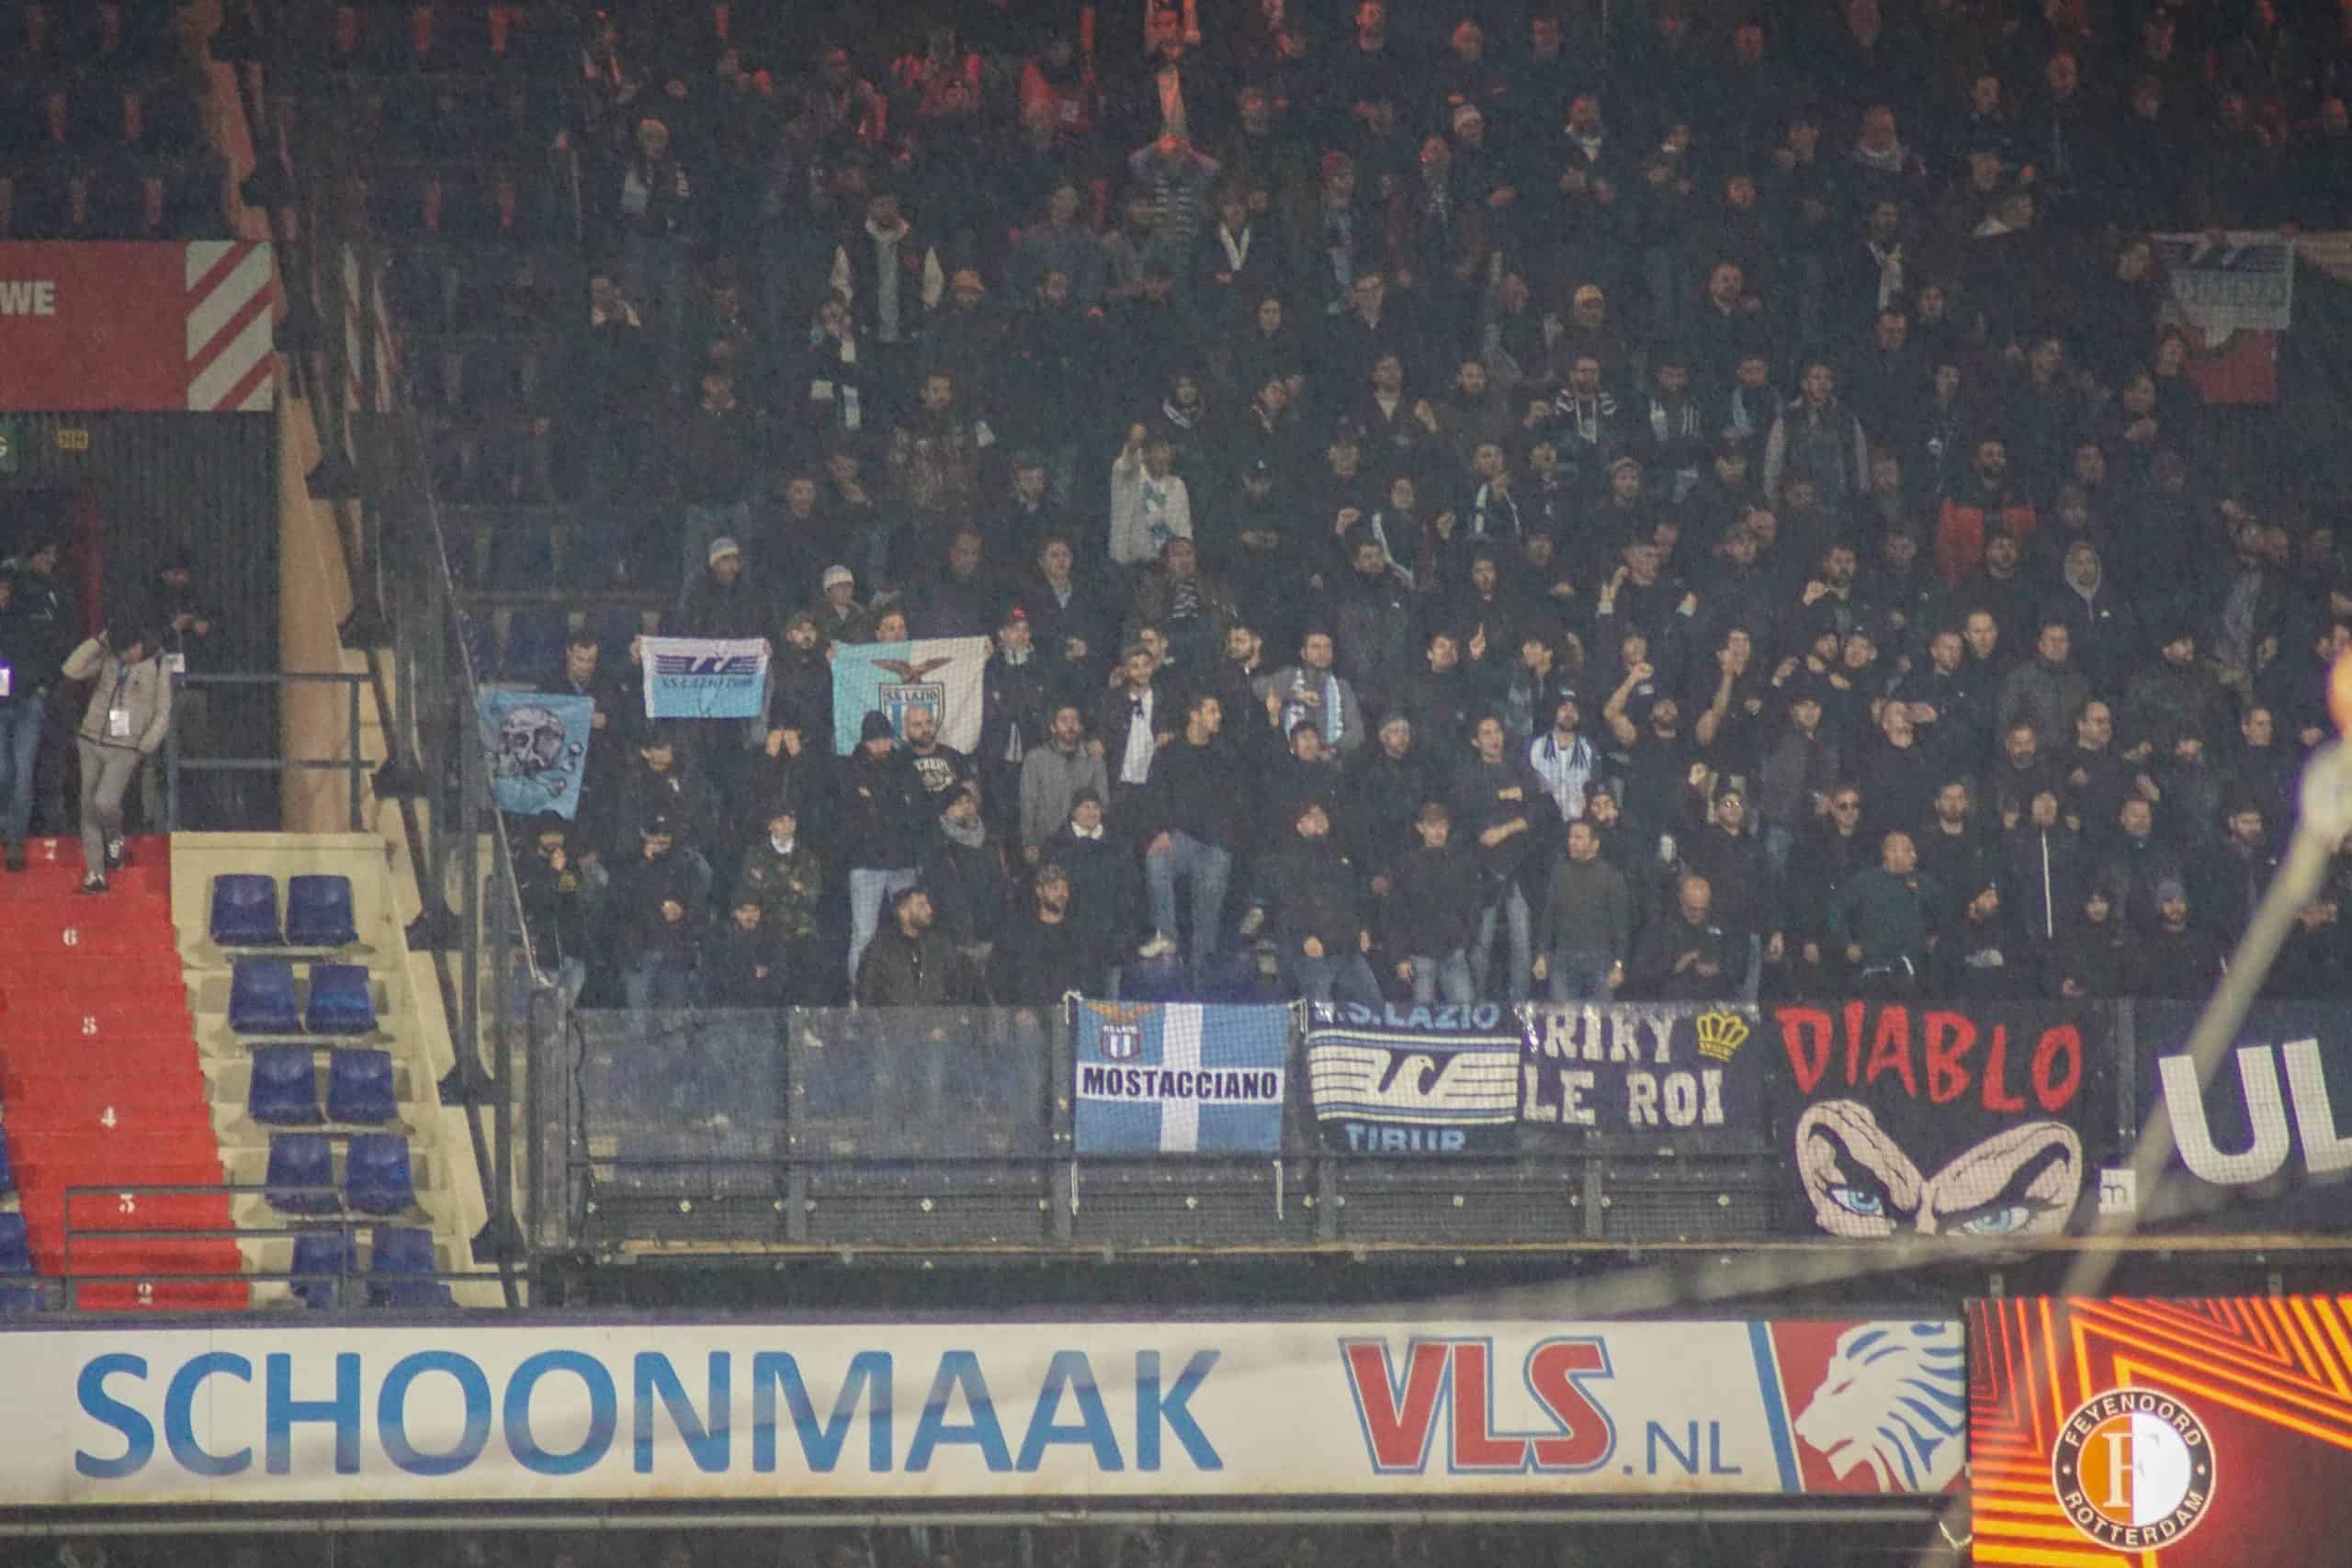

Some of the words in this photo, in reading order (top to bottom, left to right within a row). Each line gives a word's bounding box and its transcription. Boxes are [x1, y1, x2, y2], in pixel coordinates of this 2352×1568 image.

[62, 927, 78, 946] 6
[82, 1015, 97, 1035] 5
[1544, 1003, 1677, 1064] RIKY
[1082, 1066, 1278, 1100] MOSTACCIANO
[1775, 1000, 2083, 1113] DIABLO
[100, 1106, 117, 1128] 4
[1523, 1064, 1596, 1125] LE
[1626, 1069, 1725, 1127] ROI
[75, 1348, 1224, 1477] SCHOONMAAK
[2064, 1394, 2203, 1449] FEYENOORD
[2064, 1490, 2204, 1546] ROTTERDAM
